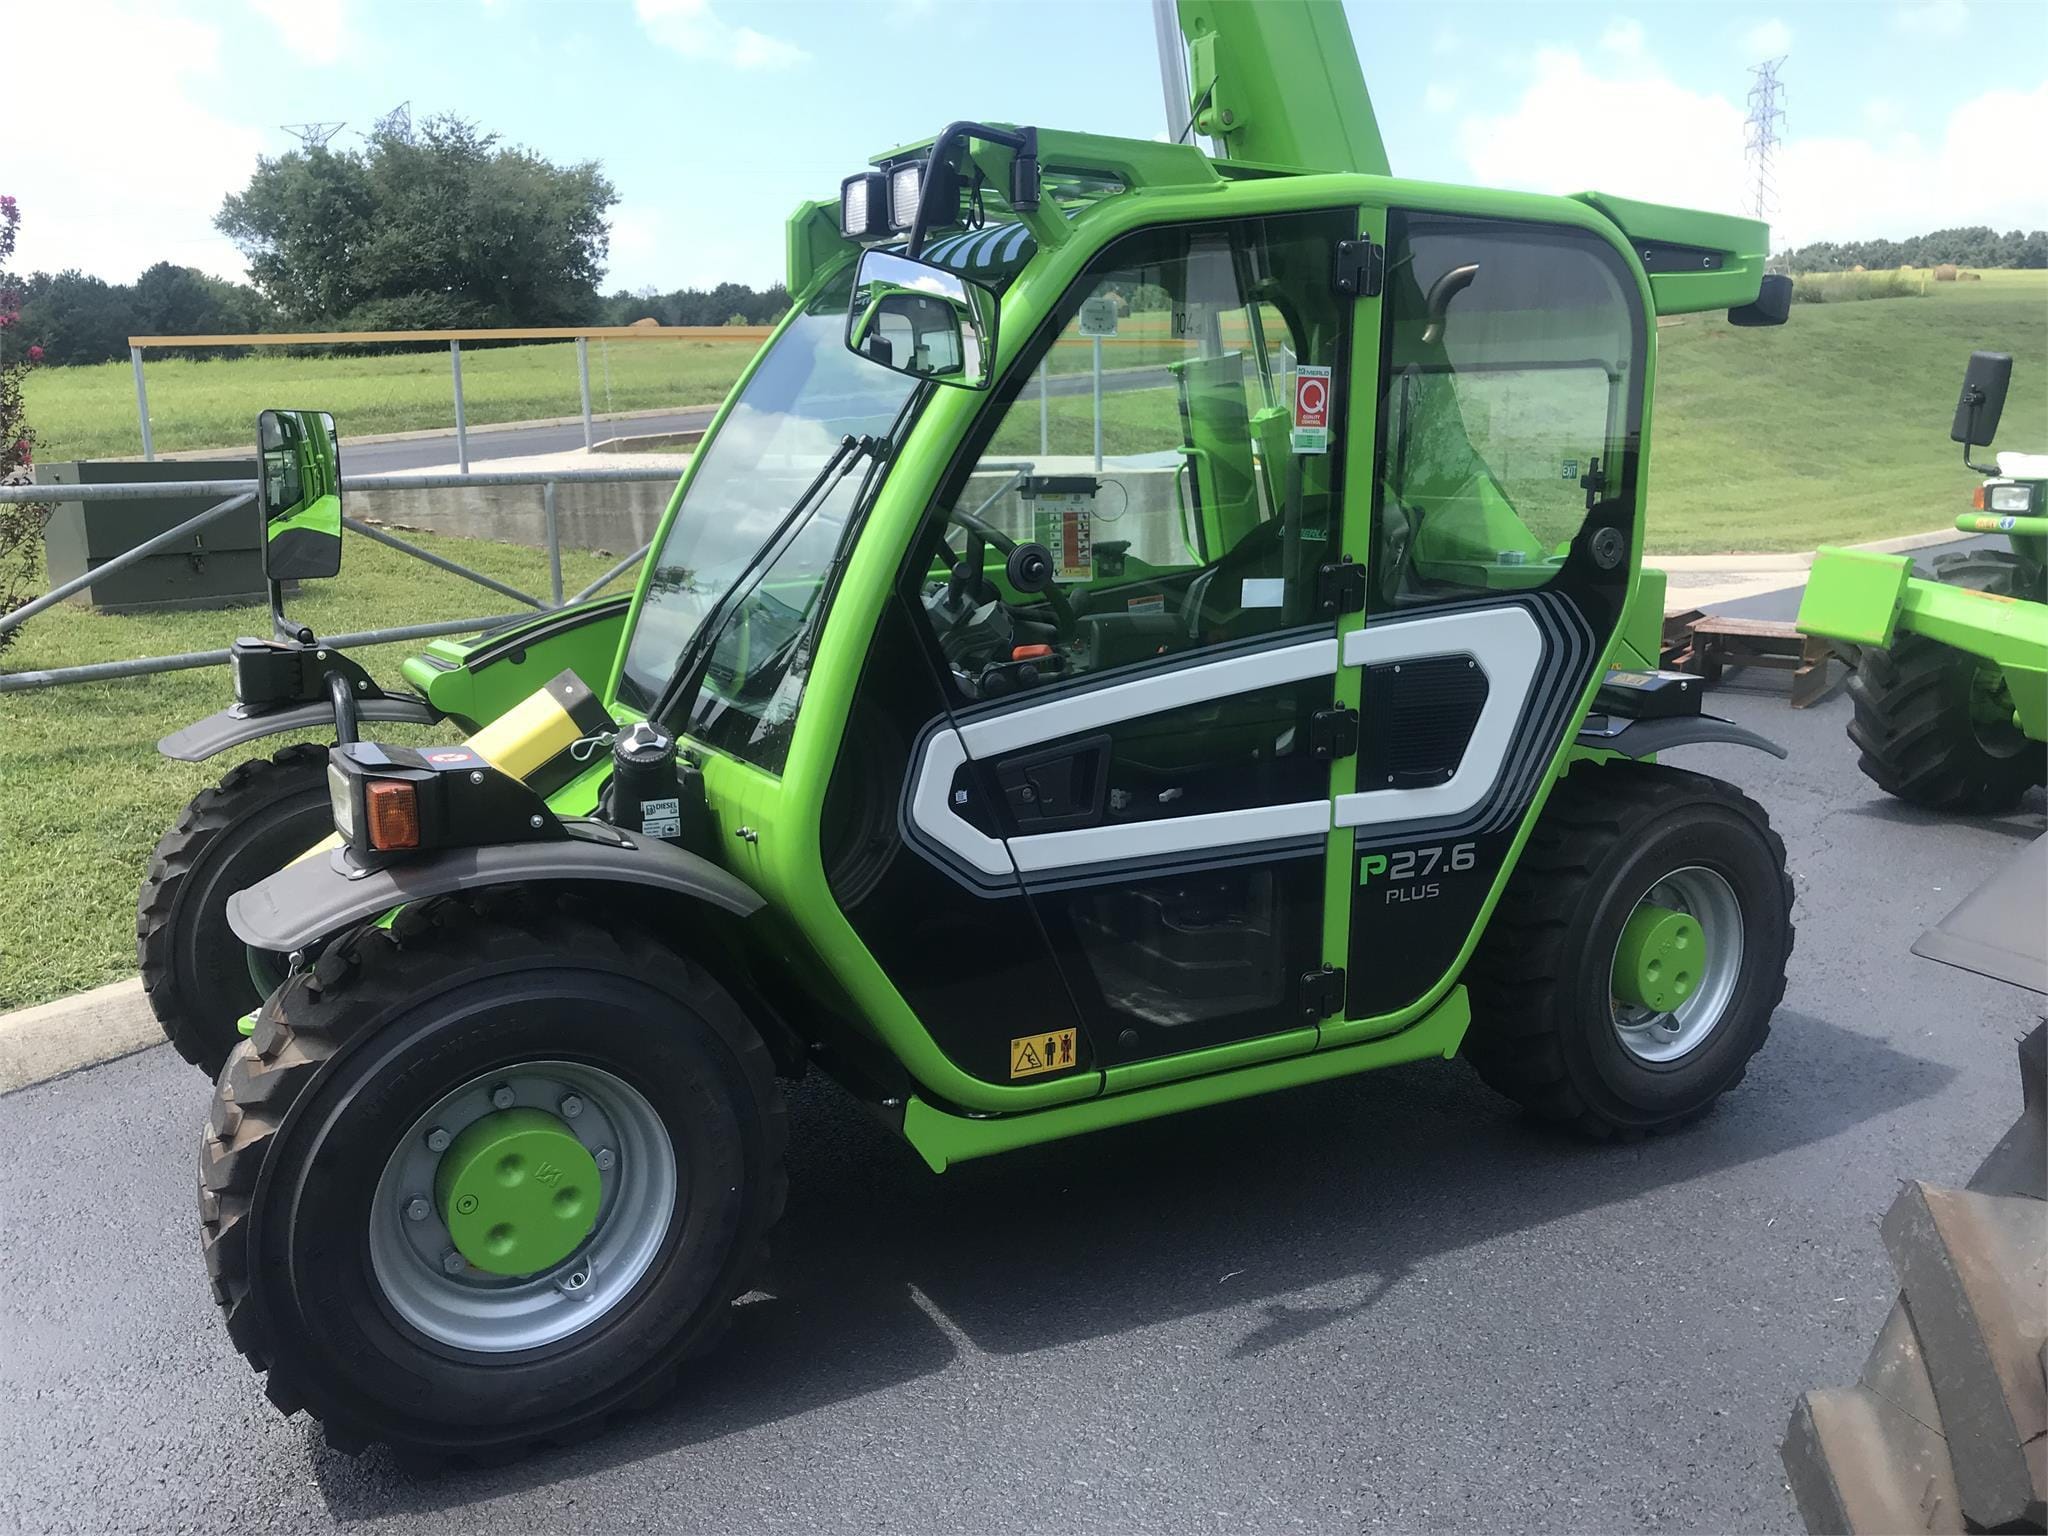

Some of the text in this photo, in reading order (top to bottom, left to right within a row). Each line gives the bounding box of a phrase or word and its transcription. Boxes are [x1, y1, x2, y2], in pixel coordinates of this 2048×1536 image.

[1299, 380, 1326, 414] Q
[655, 802, 677, 810] DIESEL
[1360, 843, 1475, 886] P27.6
[1386, 883, 1440, 904] PLUS
